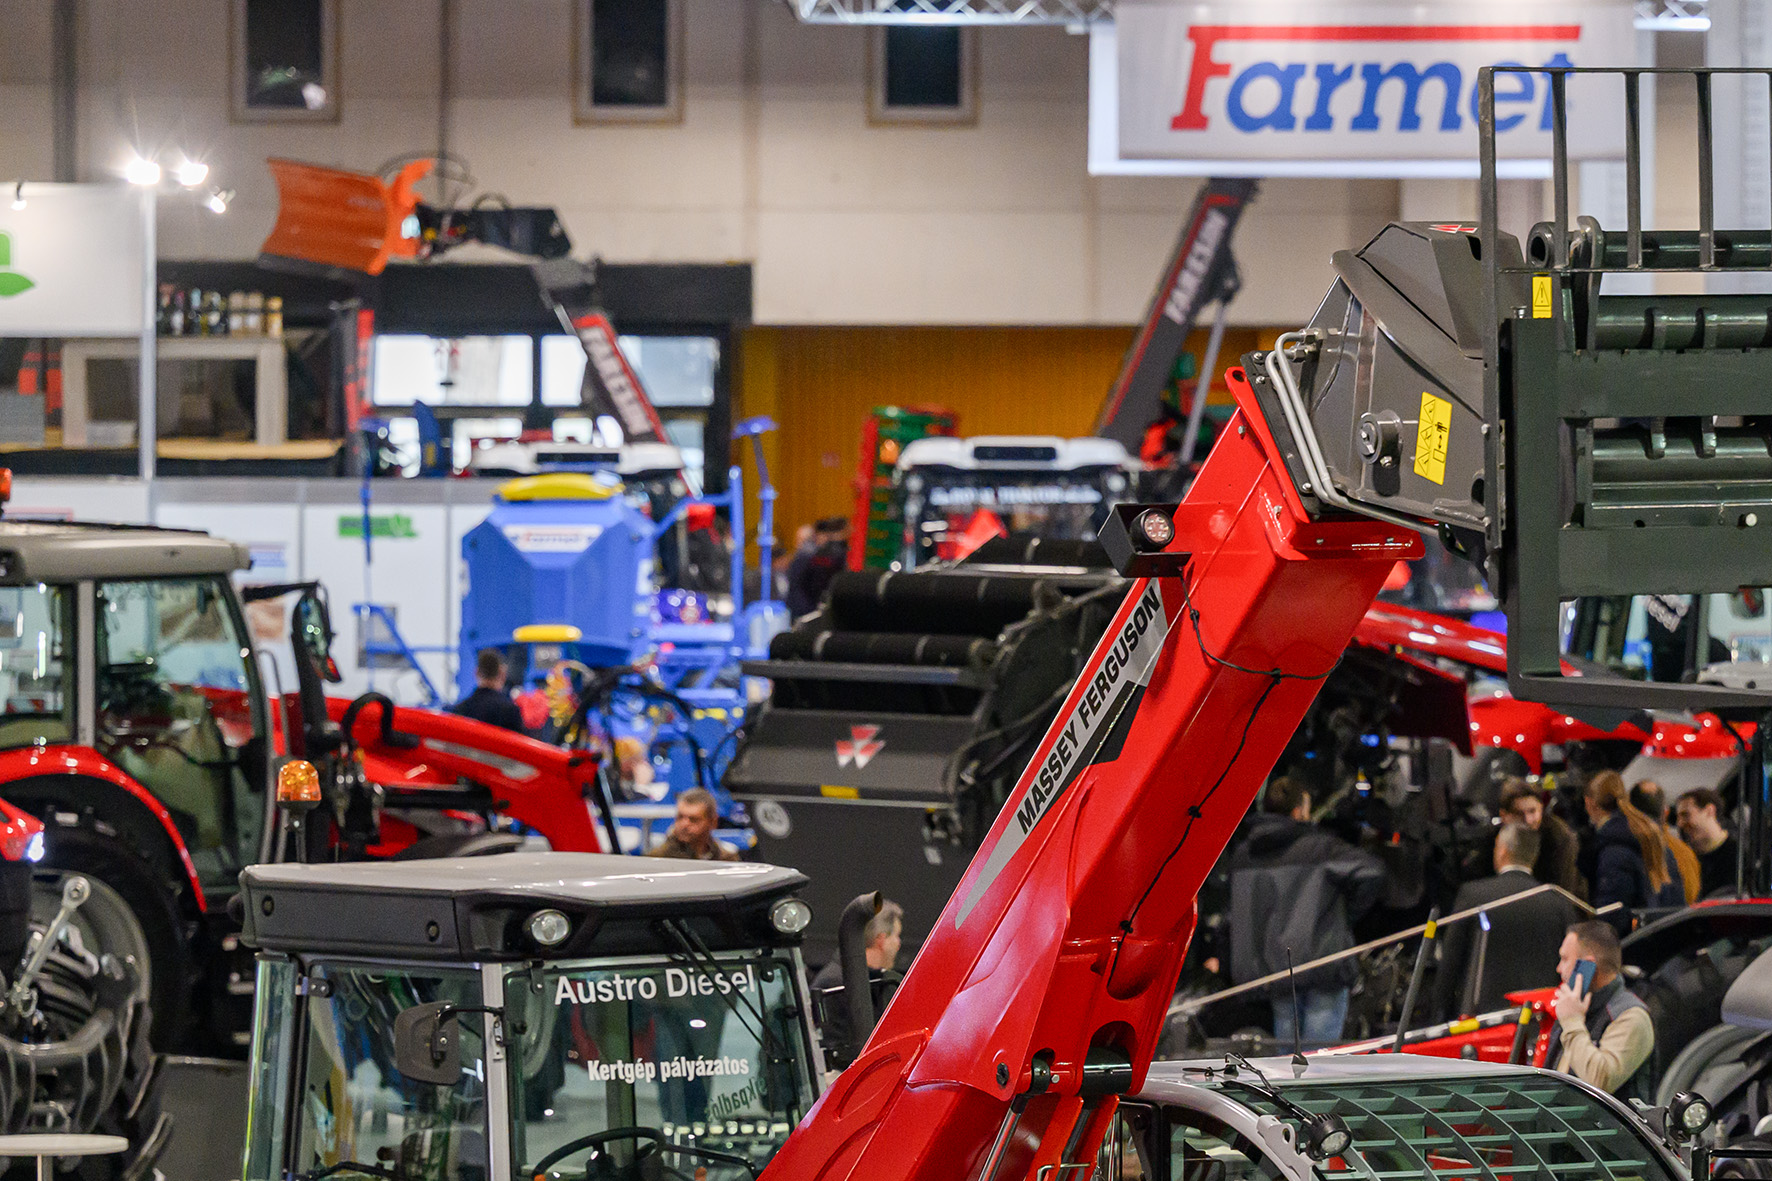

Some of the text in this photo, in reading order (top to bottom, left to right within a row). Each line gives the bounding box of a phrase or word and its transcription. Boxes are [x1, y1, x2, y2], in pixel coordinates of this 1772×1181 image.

[1170, 25, 1582, 134] Farmet
[1016, 586, 1162, 836] MASSEY FERGUSON
[555, 964, 756, 1006] Austro Diesel
[587, 1055, 750, 1084] Kertgép pályázatos
